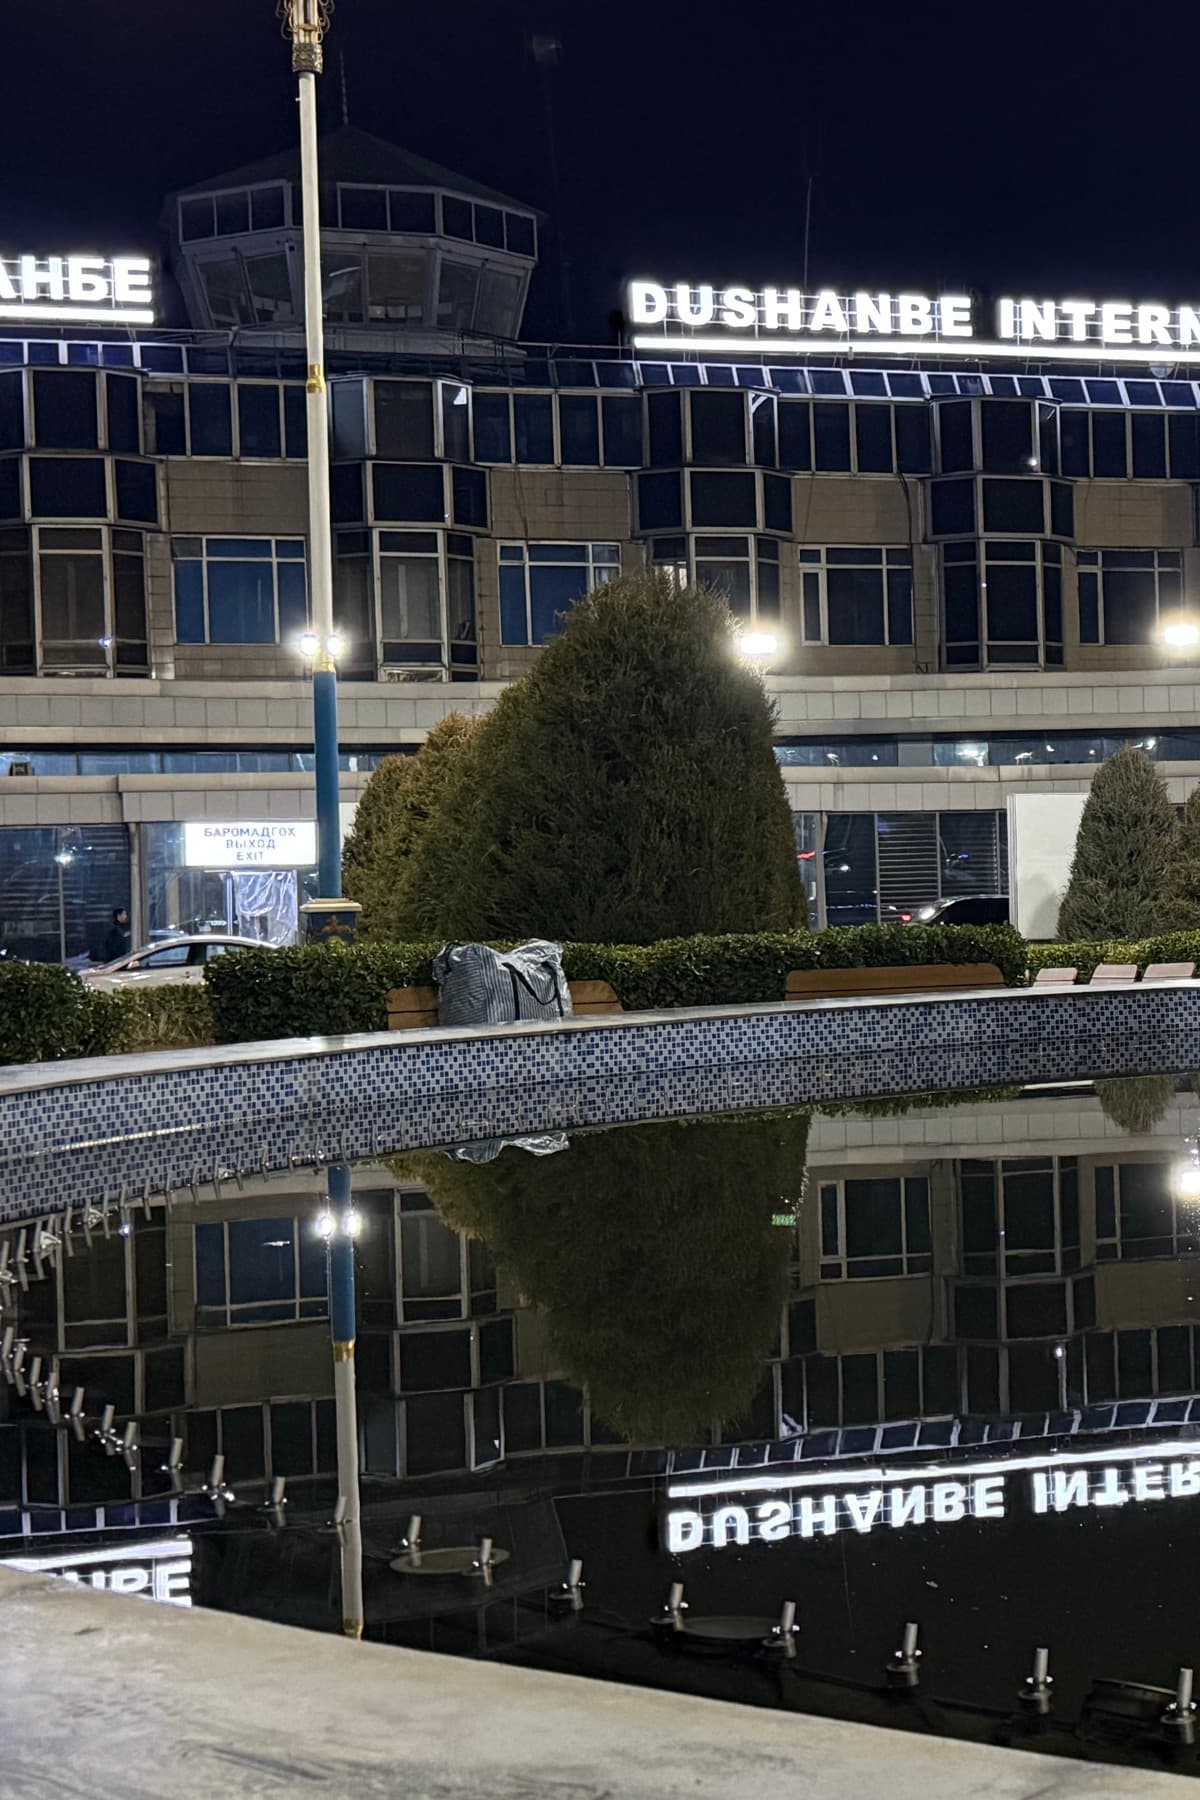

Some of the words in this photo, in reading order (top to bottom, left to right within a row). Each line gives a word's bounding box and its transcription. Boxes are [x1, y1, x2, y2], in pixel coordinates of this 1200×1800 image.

[630, 282, 973, 337] DUSHANBE
[226, 839, 276, 849] ВЫХОД
[236, 851, 264, 861] EXIT
